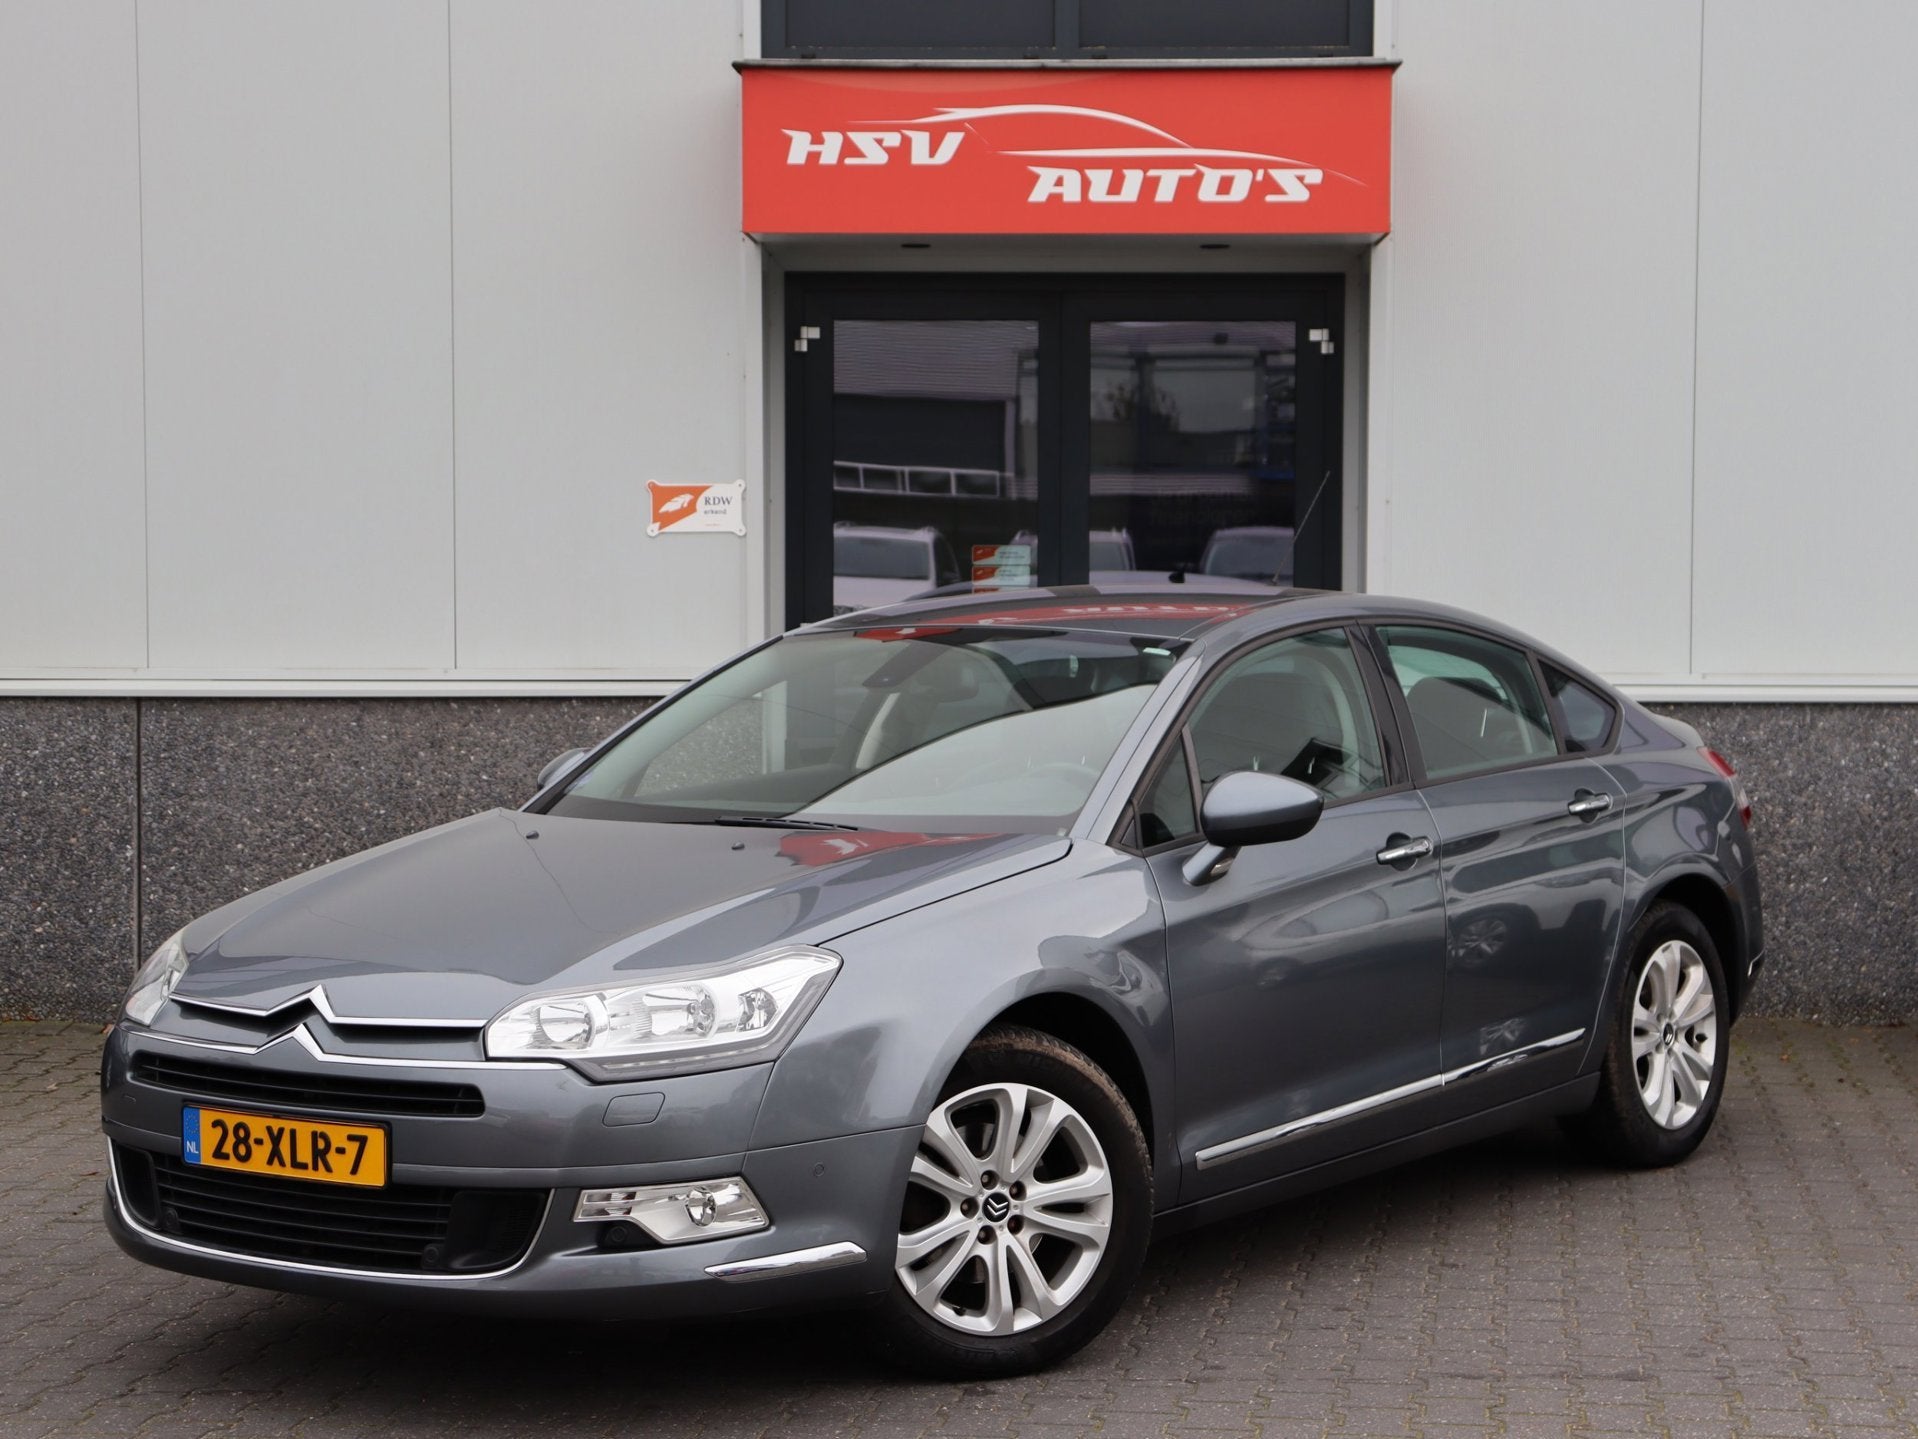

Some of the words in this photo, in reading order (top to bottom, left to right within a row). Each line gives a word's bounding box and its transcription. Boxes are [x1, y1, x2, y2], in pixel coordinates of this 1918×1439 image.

[781, 128, 966, 166] HSV
[1026, 163, 1325, 203] AUTO'S
[705, 496, 732, 505] RDW
[186, 1140, 199, 1155] NL
[211, 1118, 369, 1176] 28-XLR-7
